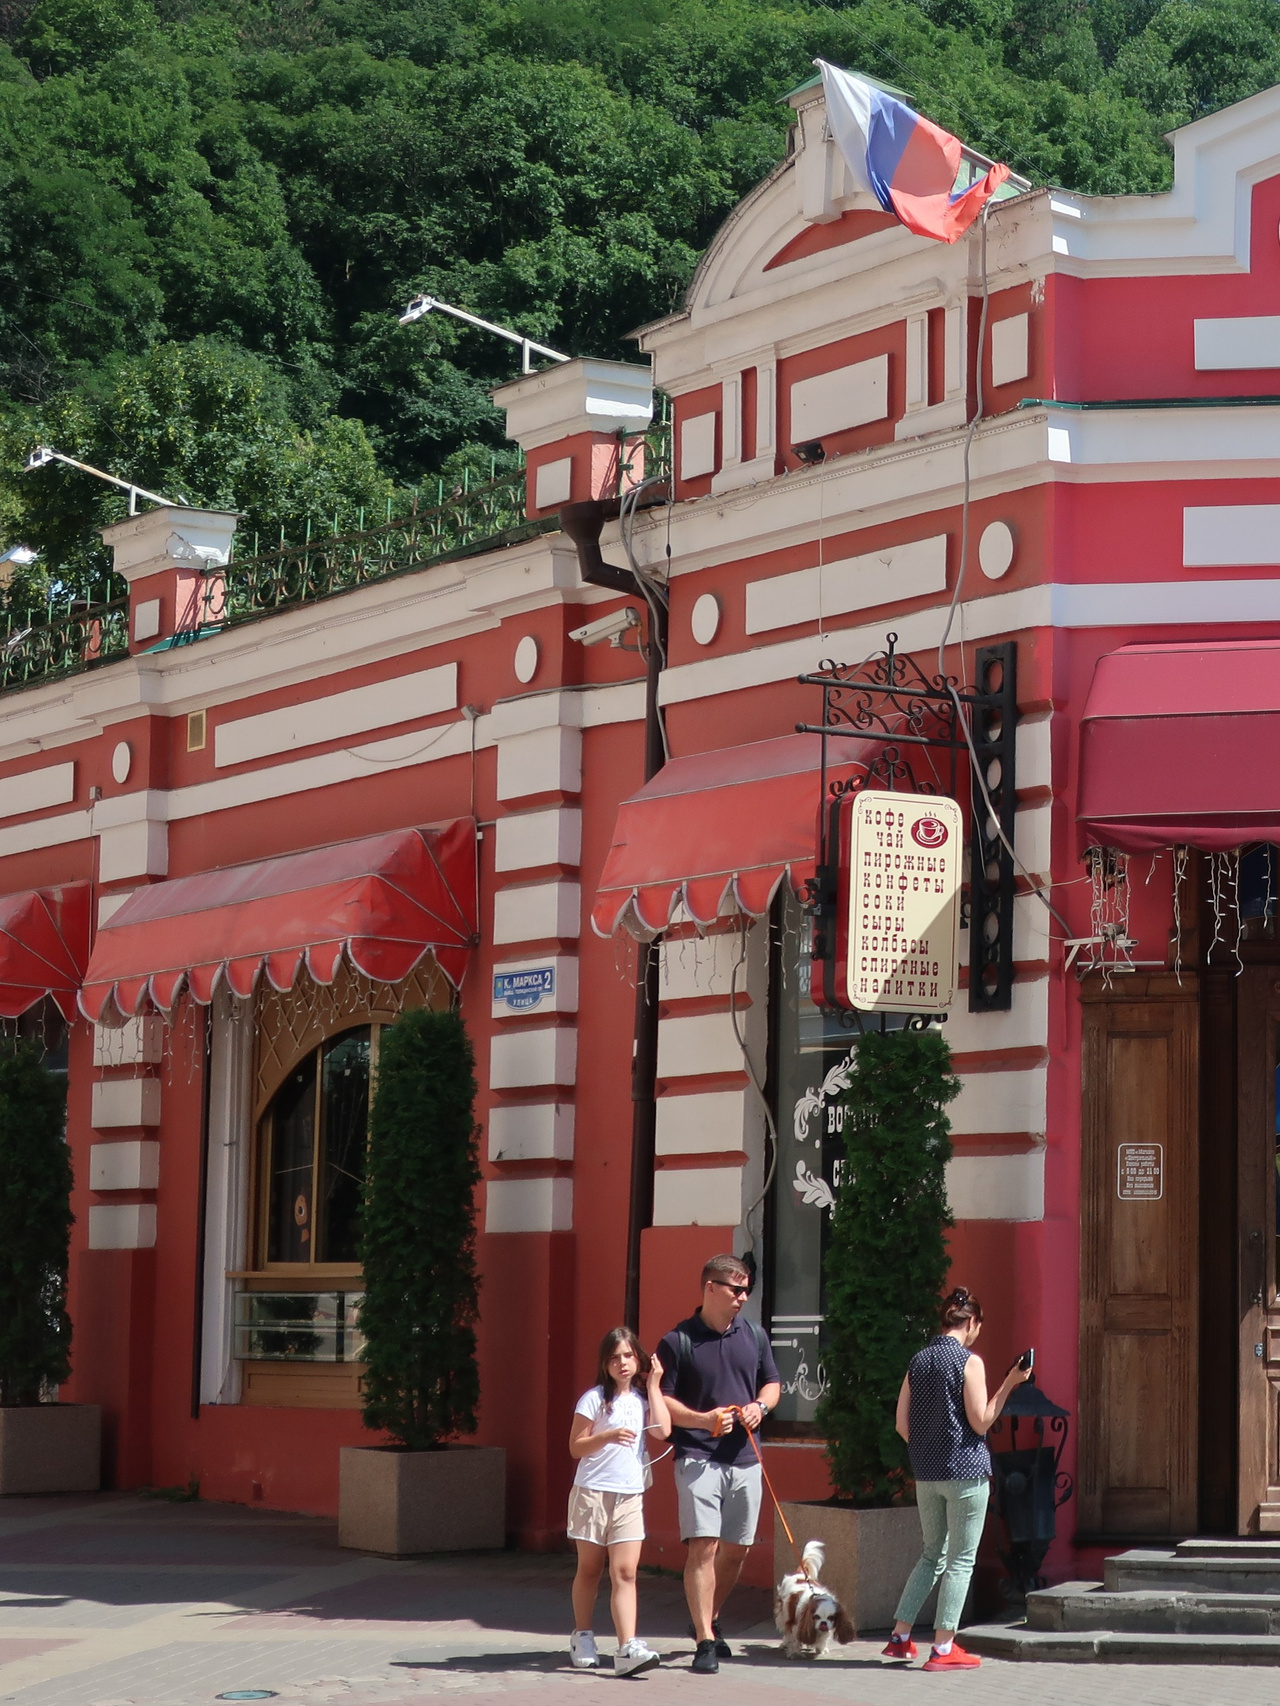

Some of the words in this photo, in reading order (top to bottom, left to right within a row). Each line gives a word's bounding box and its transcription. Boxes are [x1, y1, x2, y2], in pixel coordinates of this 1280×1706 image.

[865, 808, 904, 831] кофе
[876, 829, 904, 848] чай
[864, 852, 946, 873] пирожные
[863, 872, 944, 894] конфеты
[863, 894, 904, 911] соки
[862, 915, 904, 935] сыры
[861, 934, 929, 955] колбасы
[860, 957, 939, 978] спиртные
[513, 975, 542, 987] МАРКСА
[544, 971, 551, 989] 2
[860, 977, 938, 997] напитки
